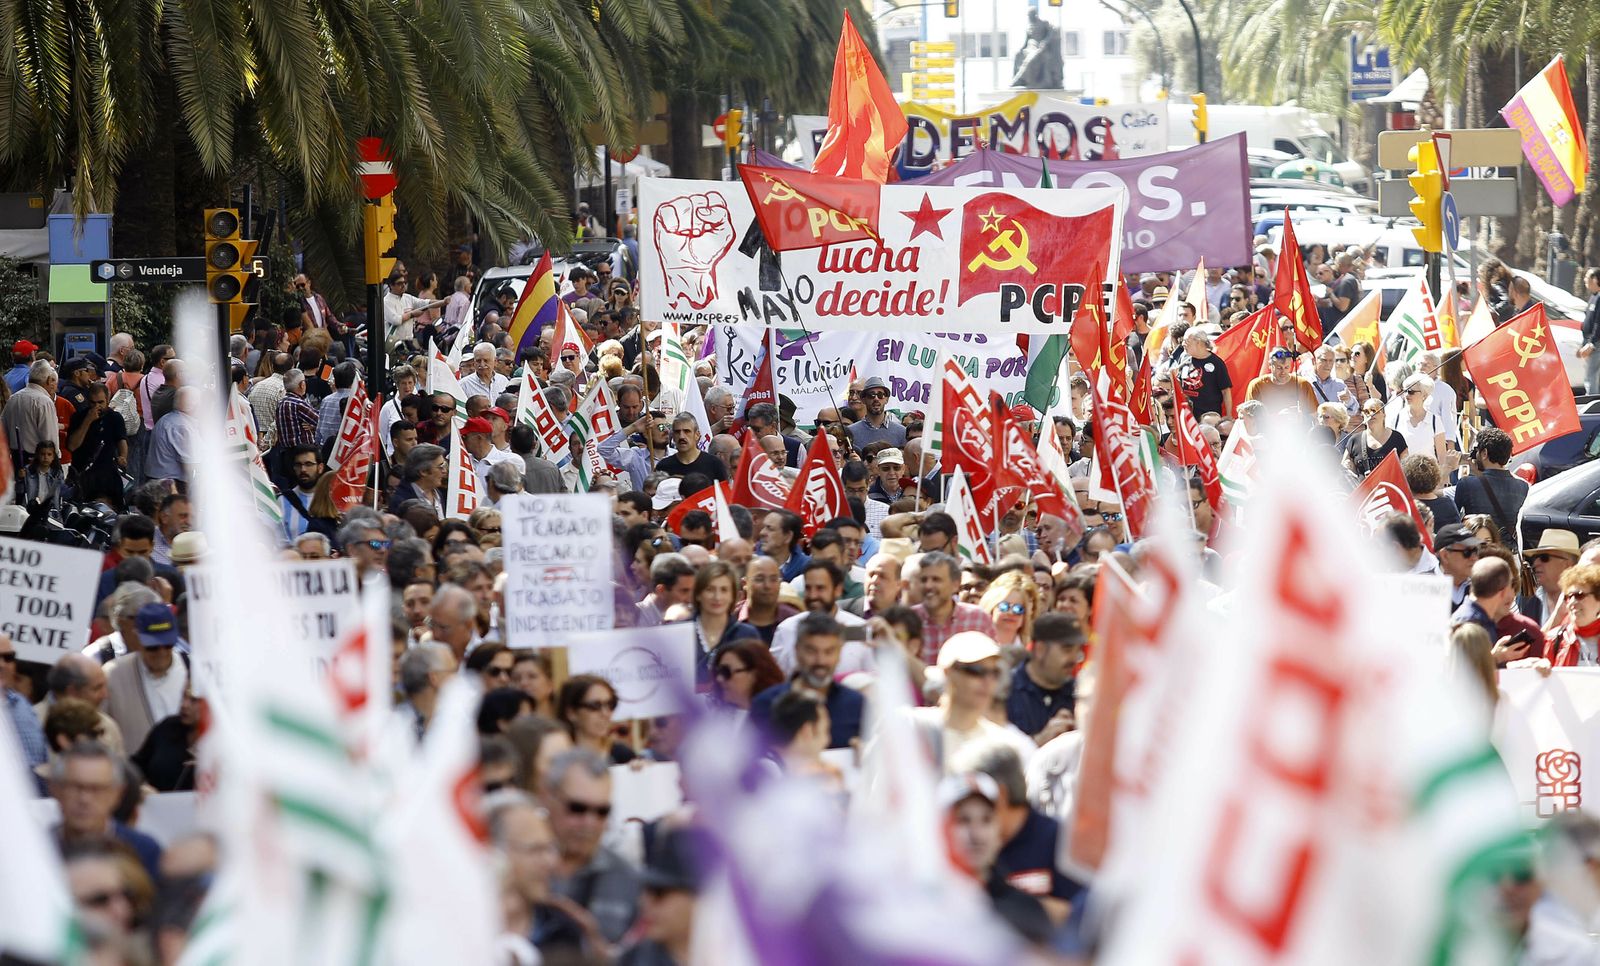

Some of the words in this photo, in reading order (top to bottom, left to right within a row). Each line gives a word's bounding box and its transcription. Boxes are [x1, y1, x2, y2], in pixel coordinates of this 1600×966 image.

[810, 105, 1114, 169] DEMOS
[138, 265, 183, 278] Vendeja
[816, 244, 921, 274] lucha
[736, 274, 815, 325] MAYO
[814, 279, 950, 318] decide!
[662, 311, 740, 324] www.pcpe.es
[794, 357, 855, 387] Unión
[876, 338, 905, 363] EN
[985, 355, 1028, 379] POR
[1486, 370, 1546, 444] PCPE
[585, 438, 603, 475] Malag
[518, 500, 545, 514] NO
[552, 499, 574, 512] AL
[516, 515, 600, 538] TRABAJO
[510, 544, 595, 562] PRECARIO
[331, 567, 351, 595] LA
[15, 594, 73, 621] TODA
[512, 589, 605, 607] TRABAJO
[2, 622, 71, 650] GENTE
[509, 613, 609, 633] INDECENTE
